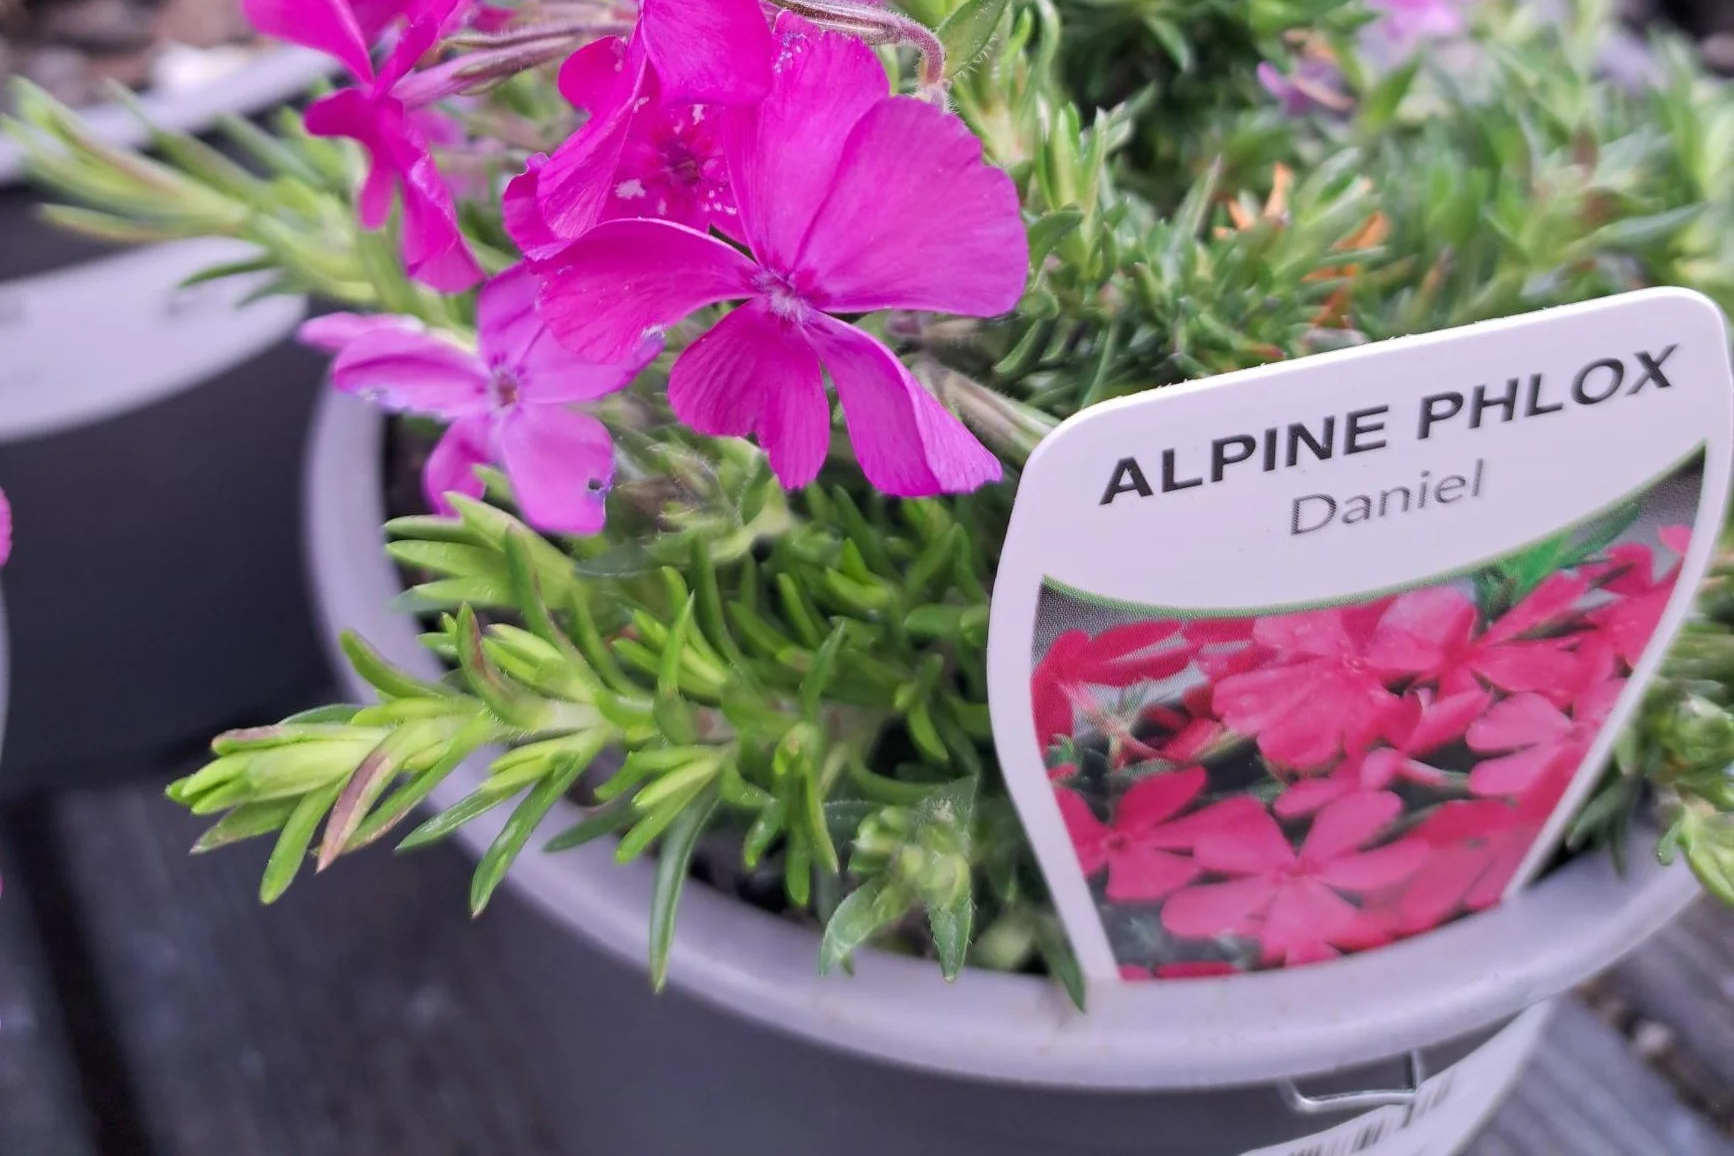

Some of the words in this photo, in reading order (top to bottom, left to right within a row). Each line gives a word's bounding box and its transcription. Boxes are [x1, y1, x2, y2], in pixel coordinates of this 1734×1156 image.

[1099, 405, 1389, 506] ALPINE
[1416, 343, 1680, 439] PHLOX
[1290, 458, 1484, 536] Daniel
